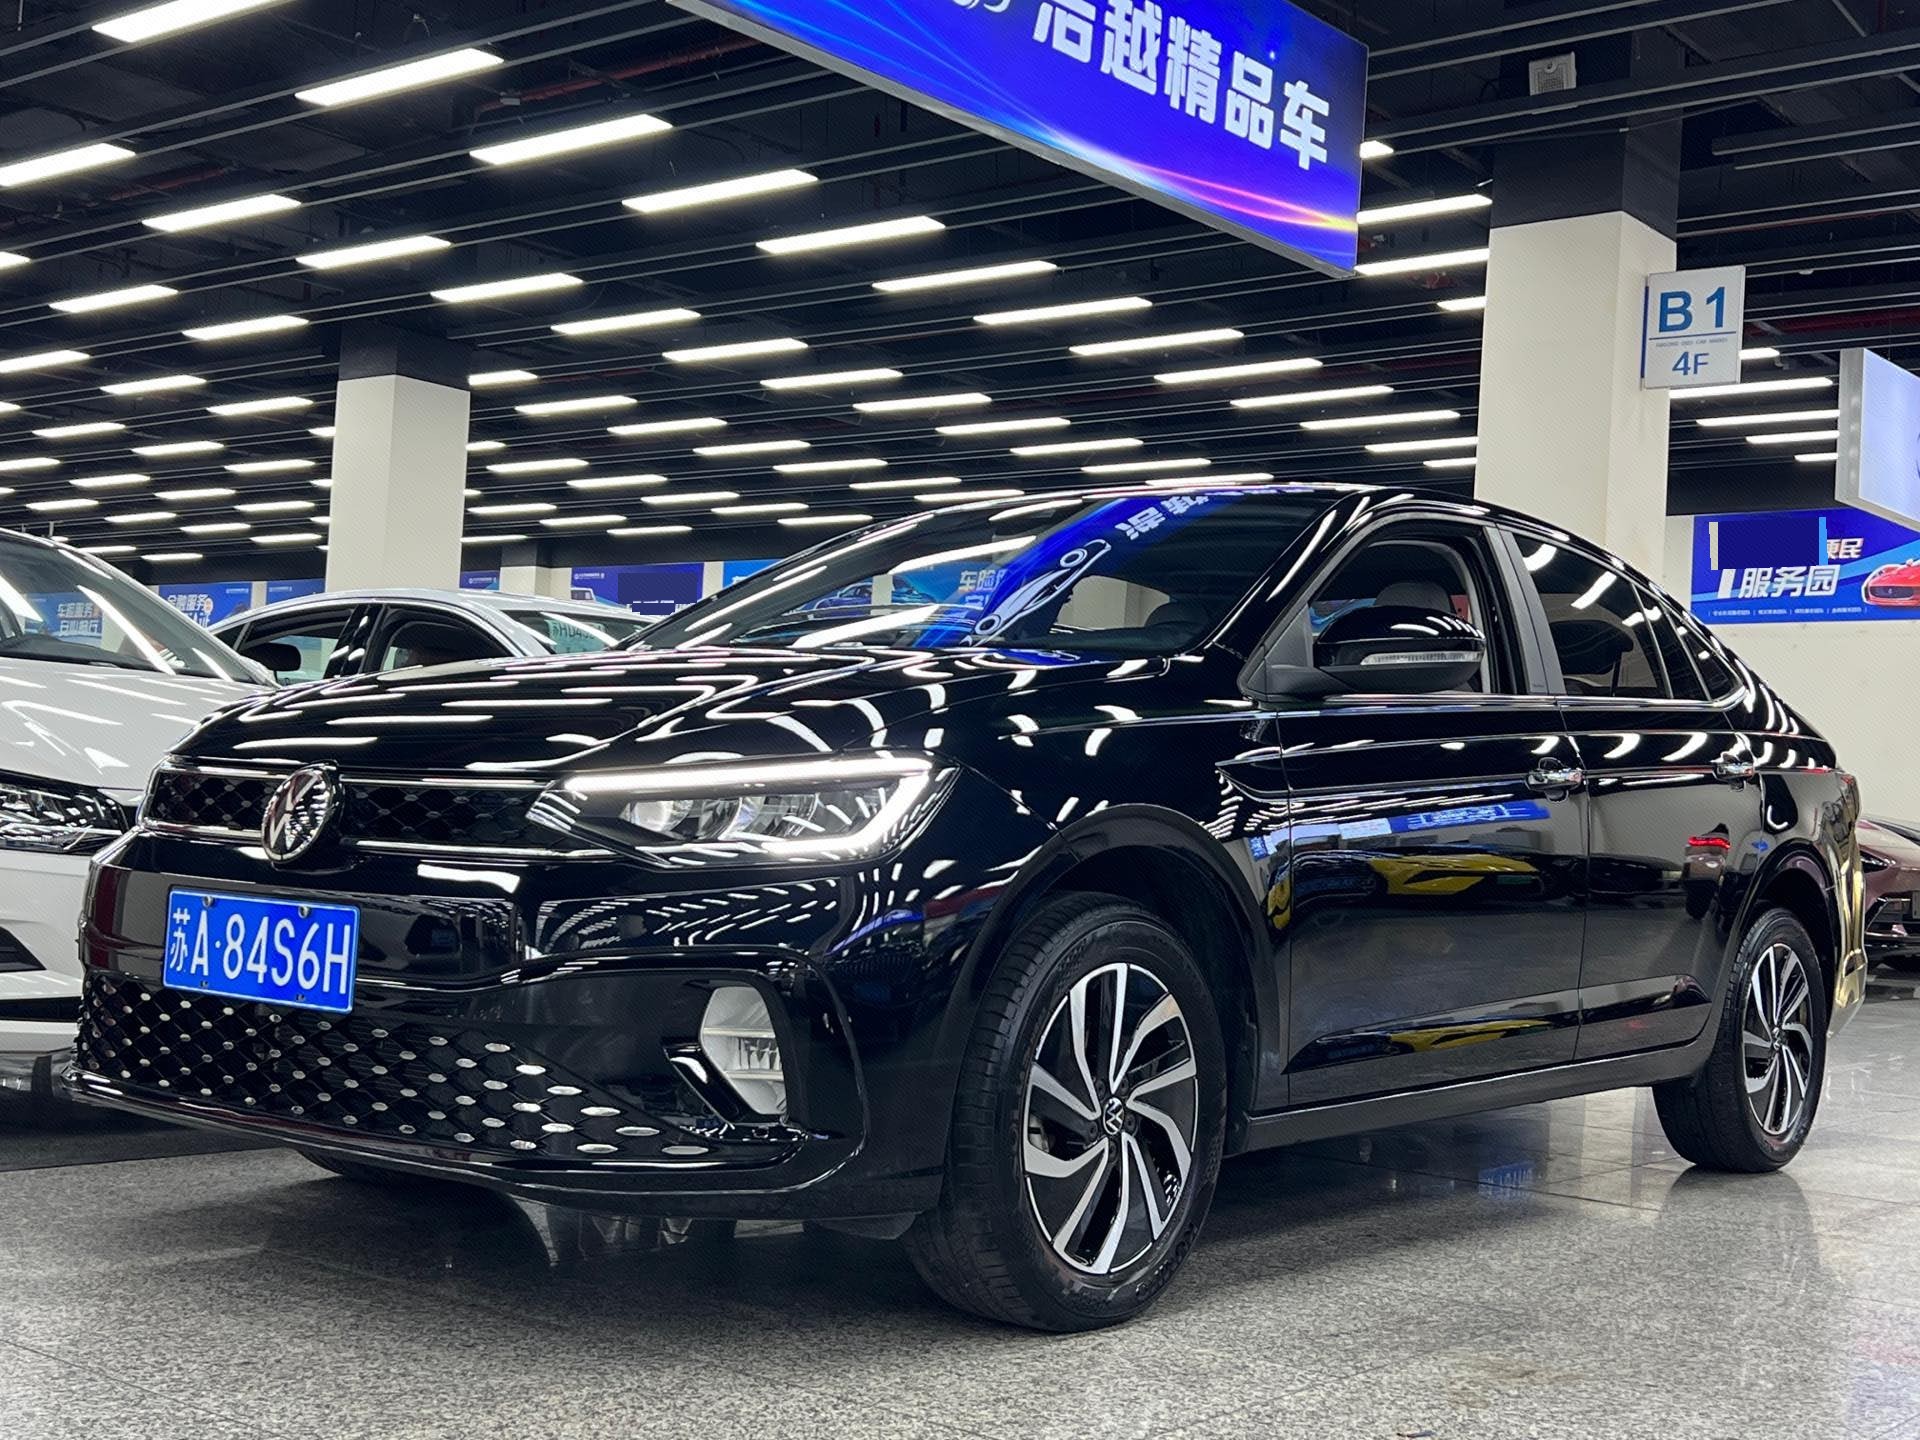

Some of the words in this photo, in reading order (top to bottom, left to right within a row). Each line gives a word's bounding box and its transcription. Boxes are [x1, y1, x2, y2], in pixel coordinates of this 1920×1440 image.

[1672, 351, 1710, 375] 4F
[1738, 564, 1841, 599] 服务园
